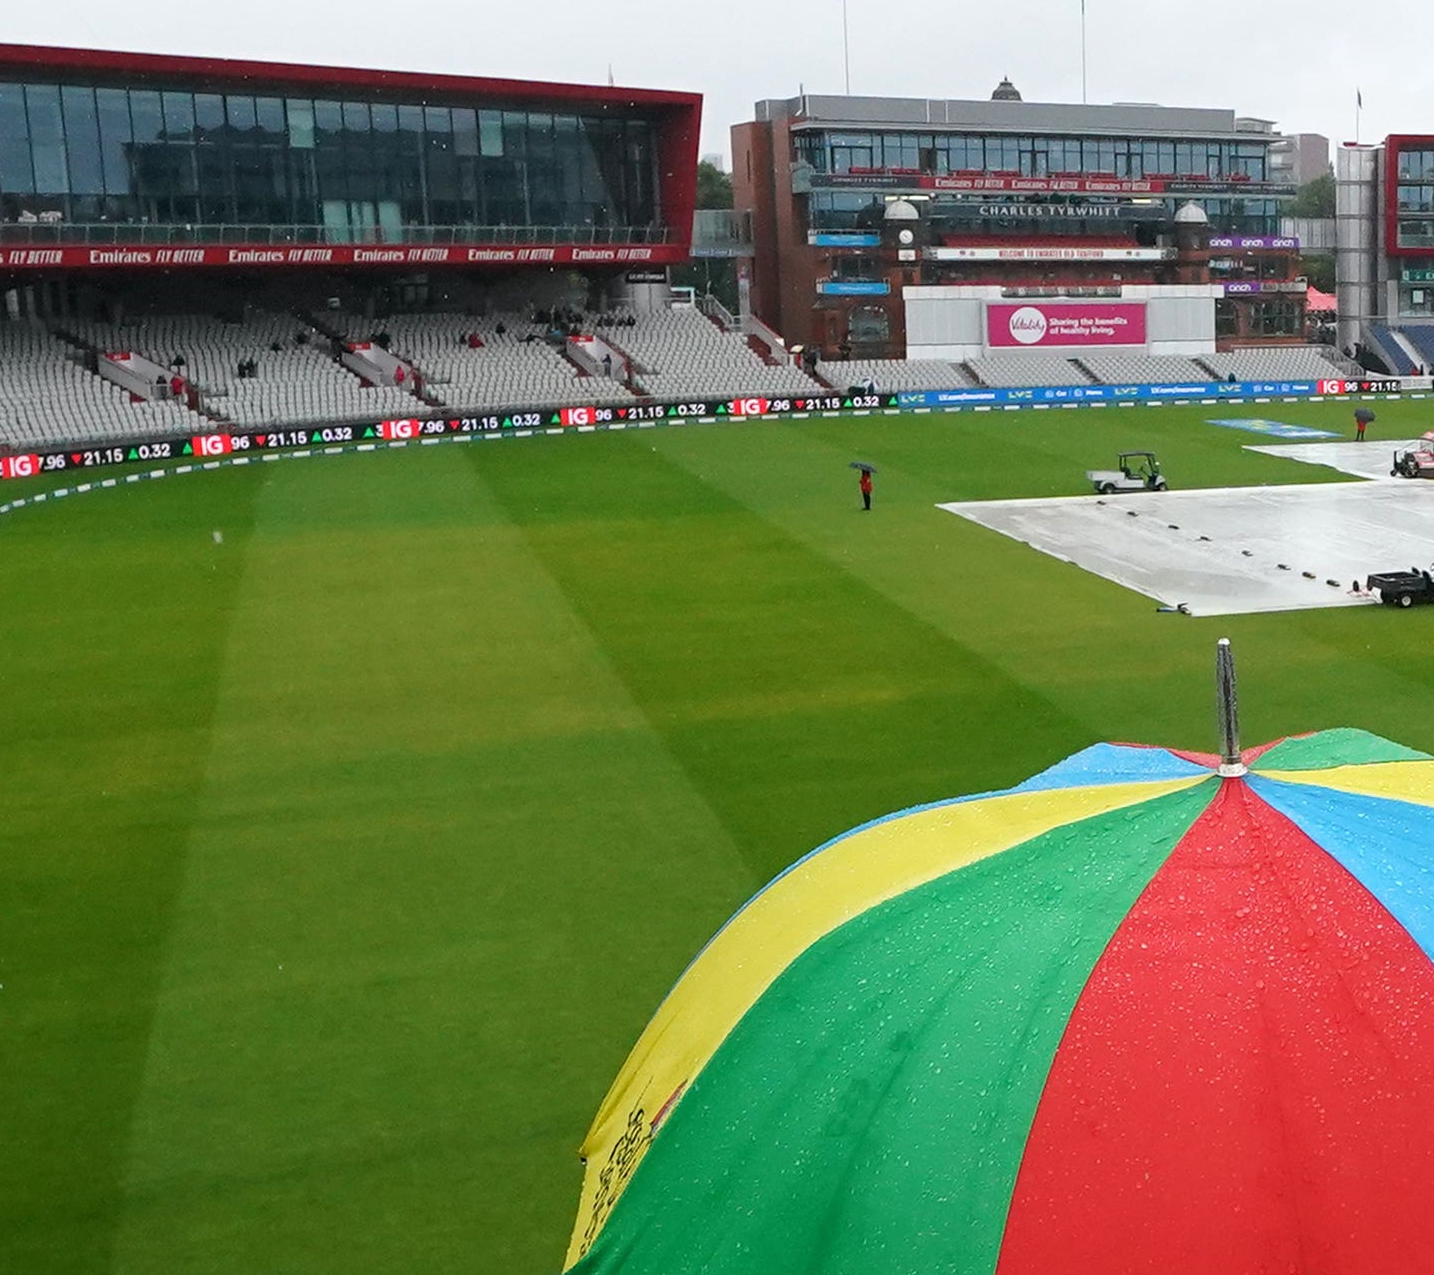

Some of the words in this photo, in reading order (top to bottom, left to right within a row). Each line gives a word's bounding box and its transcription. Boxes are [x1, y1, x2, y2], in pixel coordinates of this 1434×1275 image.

[979, 206, 1042, 216] CHARLES
[1048, 206, 1119, 216] TYRWHITT
[1210, 238, 1232, 246] cinch
[1272, 238, 1294, 246] cinch
[8, 250, 26, 264] FLY
[27, 250, 63, 264] BETTER
[90, 249, 150, 263] Emirates
[173, 249, 204, 262] BETTER
[229, 249, 284, 262] Emirates
[354, 248, 404, 261] Emirates
[468, 248, 514, 261] Emirates
[572, 248, 614, 260] Emirates
[1012, 317, 1045, 334] Vitality
[1049, 317, 1079, 327] Sharing
[1080, 317, 1093, 325] the
[1095, 317, 1127, 325] benefits
[1060, 327, 1090, 335] healthy
[201, 437, 223, 455] IG
[231, 436, 250, 451] 96
[268, 431, 306, 447] 21.15
[322, 427, 352, 441] 0.32
[10, 457, 32, 476] IG
[84, 448, 123, 466] 21.15
[138, 443, 171, 460] 0.32
